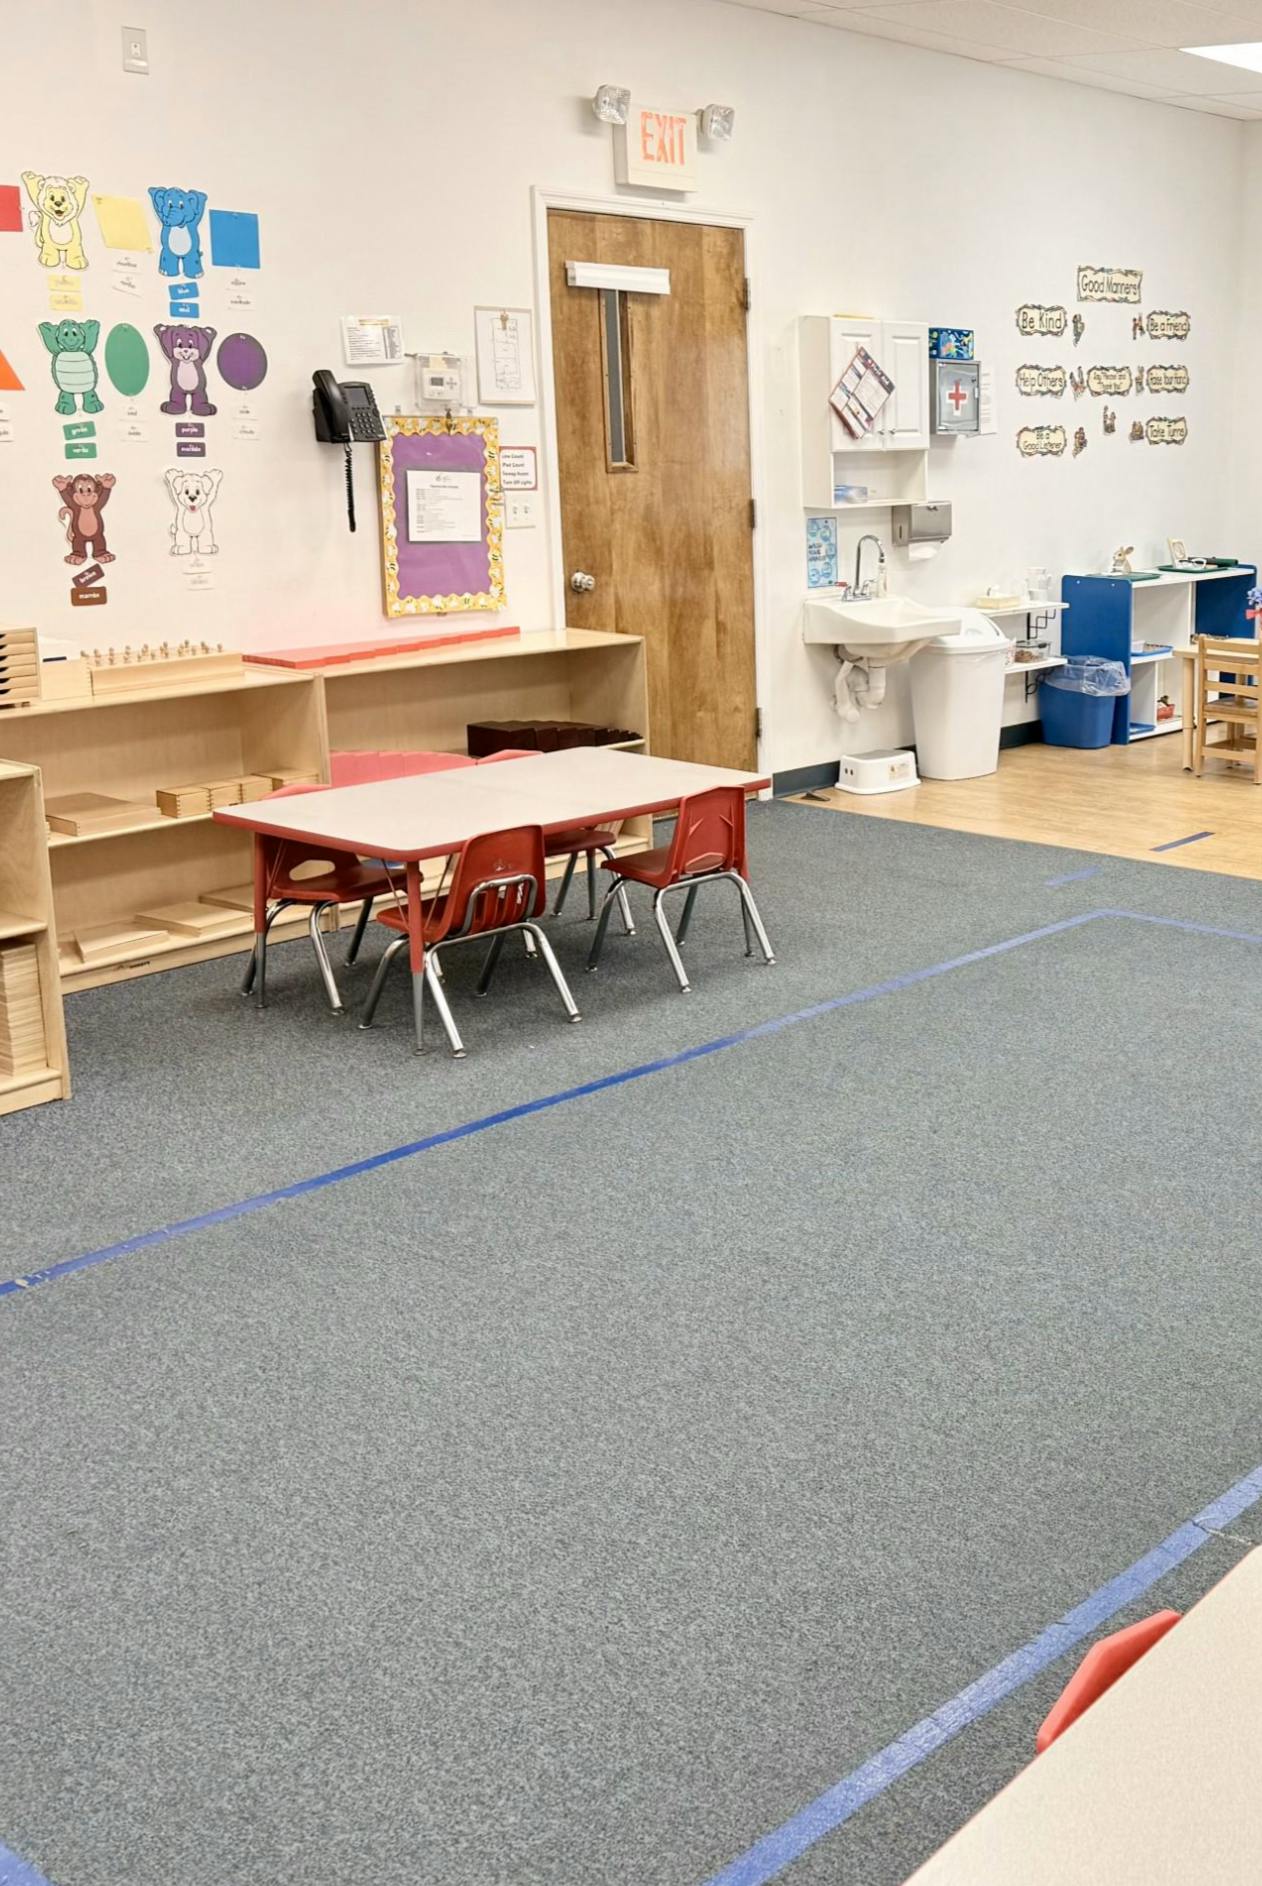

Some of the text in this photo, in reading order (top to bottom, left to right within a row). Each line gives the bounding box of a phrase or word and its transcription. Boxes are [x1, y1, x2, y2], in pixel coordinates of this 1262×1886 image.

[641, 111, 687, 165] EXIT
[1081, 274, 1137, 295] Good Manners
[1022, 310, 1062, 329] Be Kind
[1150, 318, 1159, 331] Be
[1020, 372, 1063, 392] Help Others
[1150, 424, 1185, 437] Take Turns
